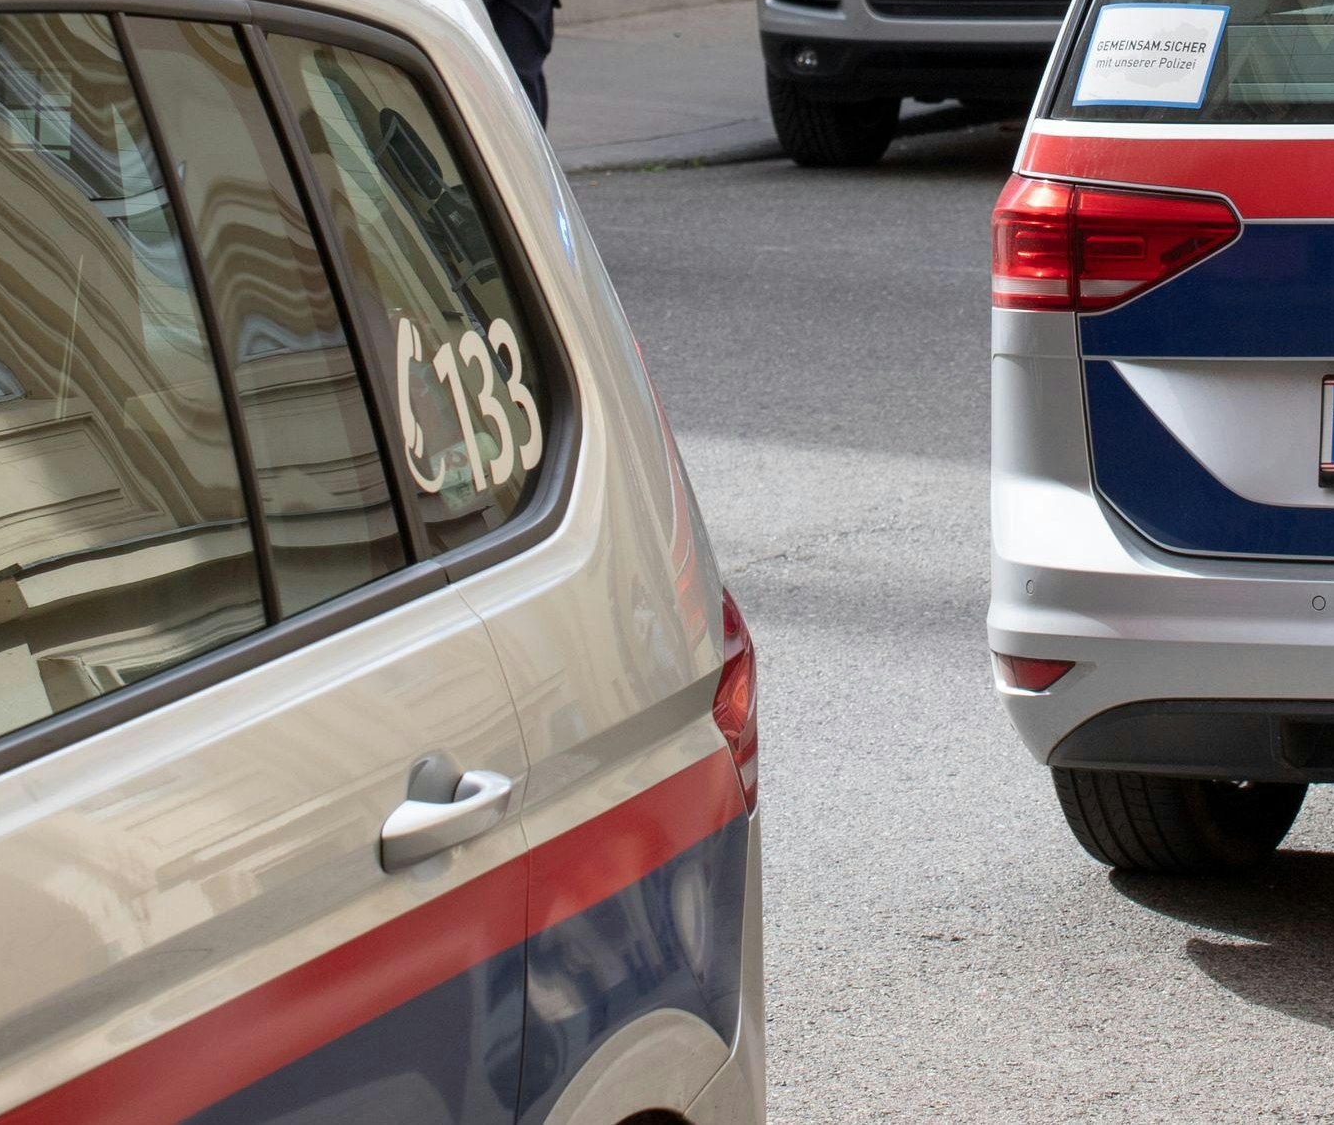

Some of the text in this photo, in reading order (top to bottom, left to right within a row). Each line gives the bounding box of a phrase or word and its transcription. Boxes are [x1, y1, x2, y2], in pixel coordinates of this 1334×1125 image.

[1096, 39, 1207, 54] GEMEINSAM.SICHER
[1095, 57, 1197, 71] mit unserer Polizei
[433, 317, 543, 492] 133
